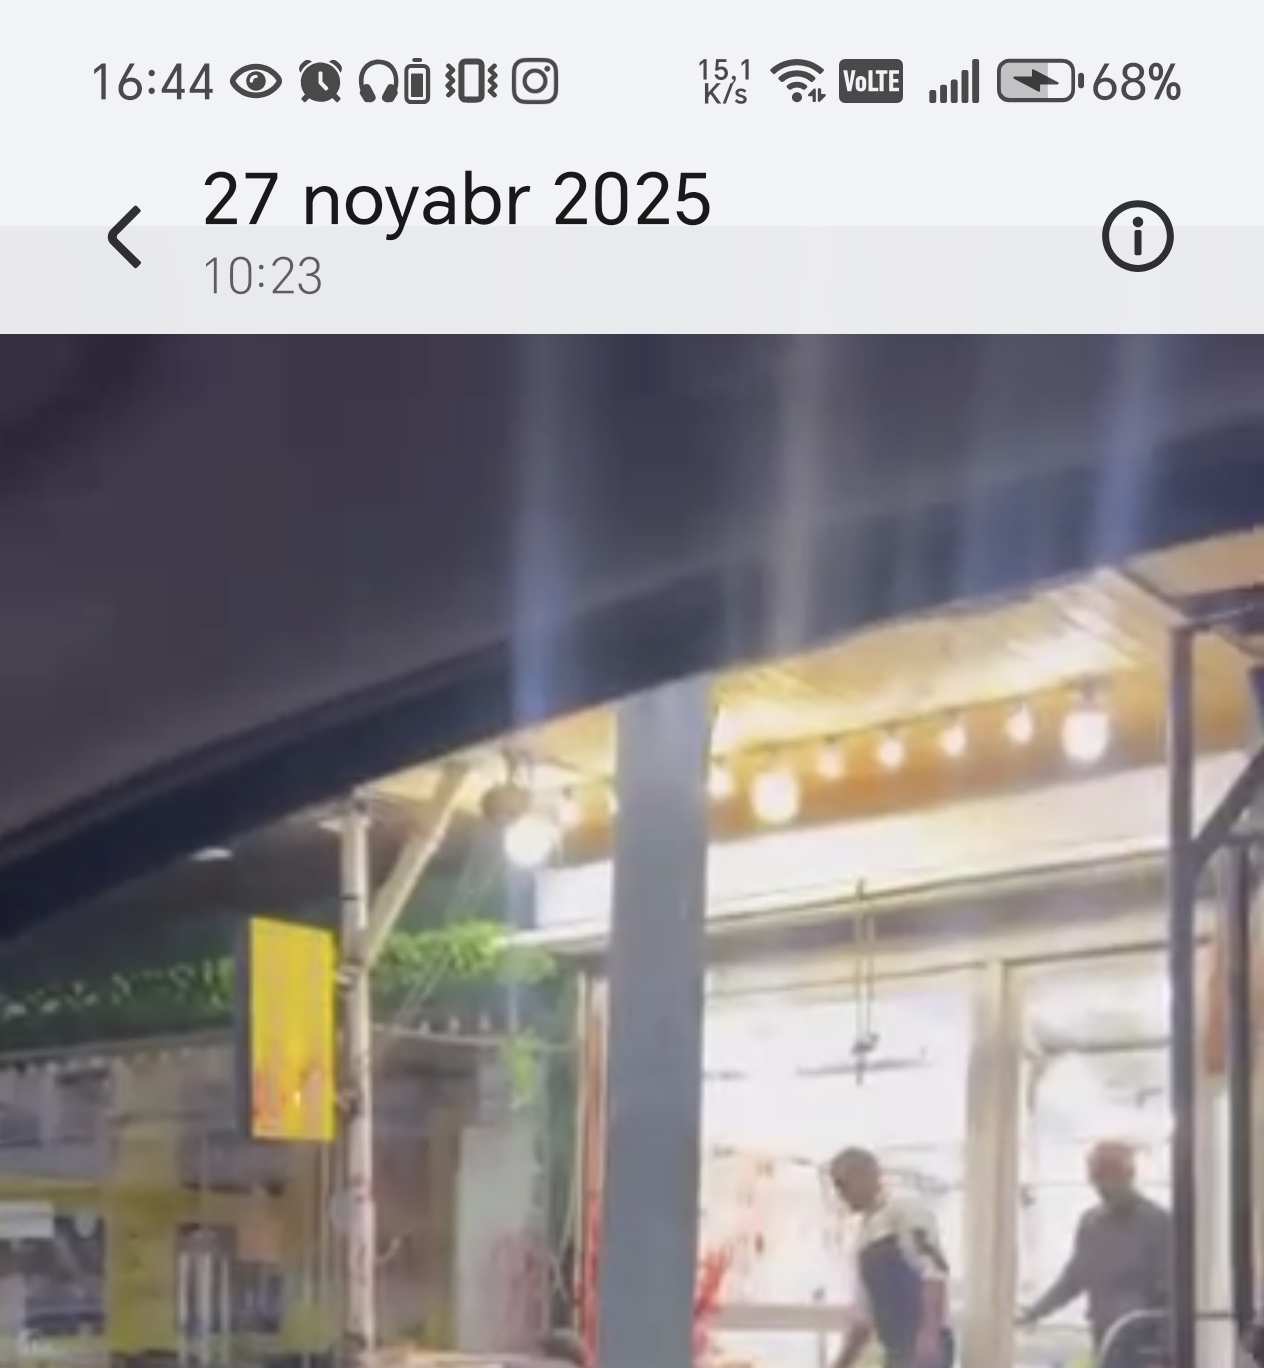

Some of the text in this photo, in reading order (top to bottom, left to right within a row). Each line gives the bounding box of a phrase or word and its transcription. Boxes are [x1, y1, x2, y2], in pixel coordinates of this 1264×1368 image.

[93, 62, 214, 101] 16:44
[699, 58, 750, 84] 15,1
[843, 69, 899, 93] VoLTE
[1092, 62, 1182, 101] 68%
[704, 82, 748, 105] K/s
[204, 169, 711, 241] 27 noyabr 2025
[205, 256, 322, 295] 10:23
